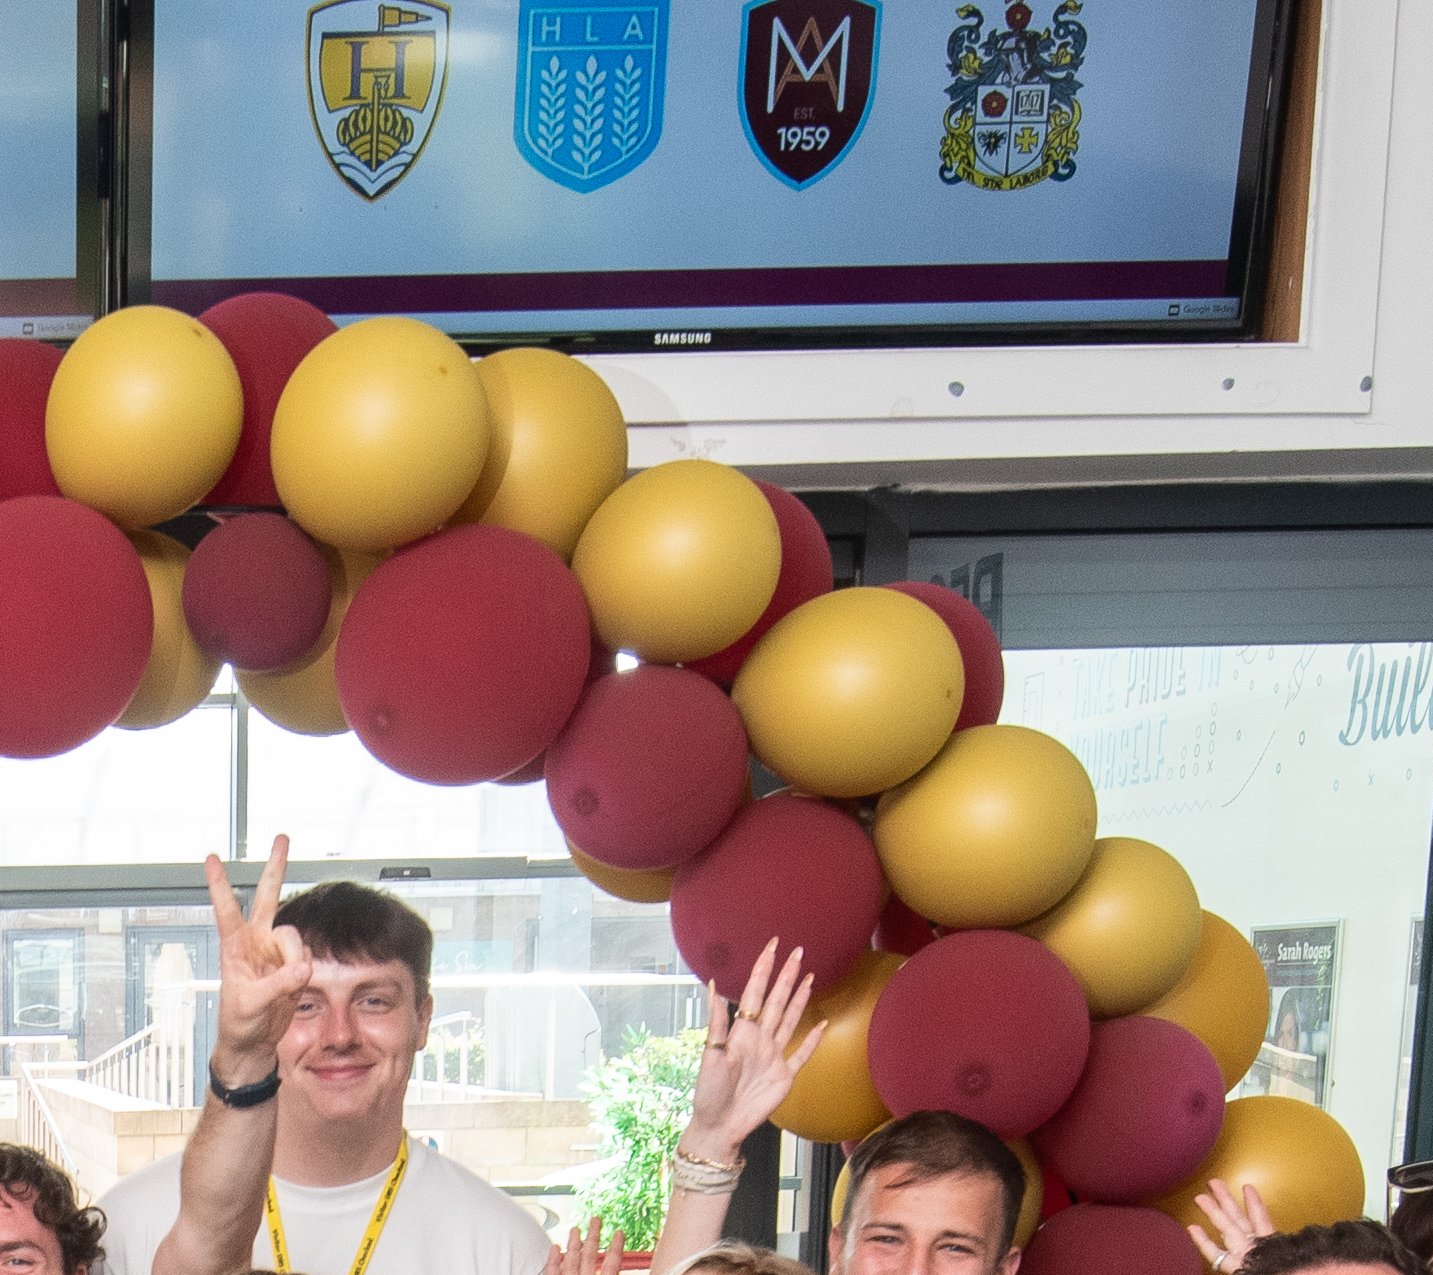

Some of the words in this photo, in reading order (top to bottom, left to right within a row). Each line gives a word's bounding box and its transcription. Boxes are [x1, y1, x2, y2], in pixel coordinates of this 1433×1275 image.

[344, 40, 409, 102] H
[777, 127, 830, 152] 1959
[654, 333, 711, 346] SAMSUNG
[1072, 651, 1115, 721] TAKE
[1125, 647, 1186, 709] PRIDE
[1277, 942, 1301, 960] Sarah
[1303, 942, 1332, 962] Rogers
